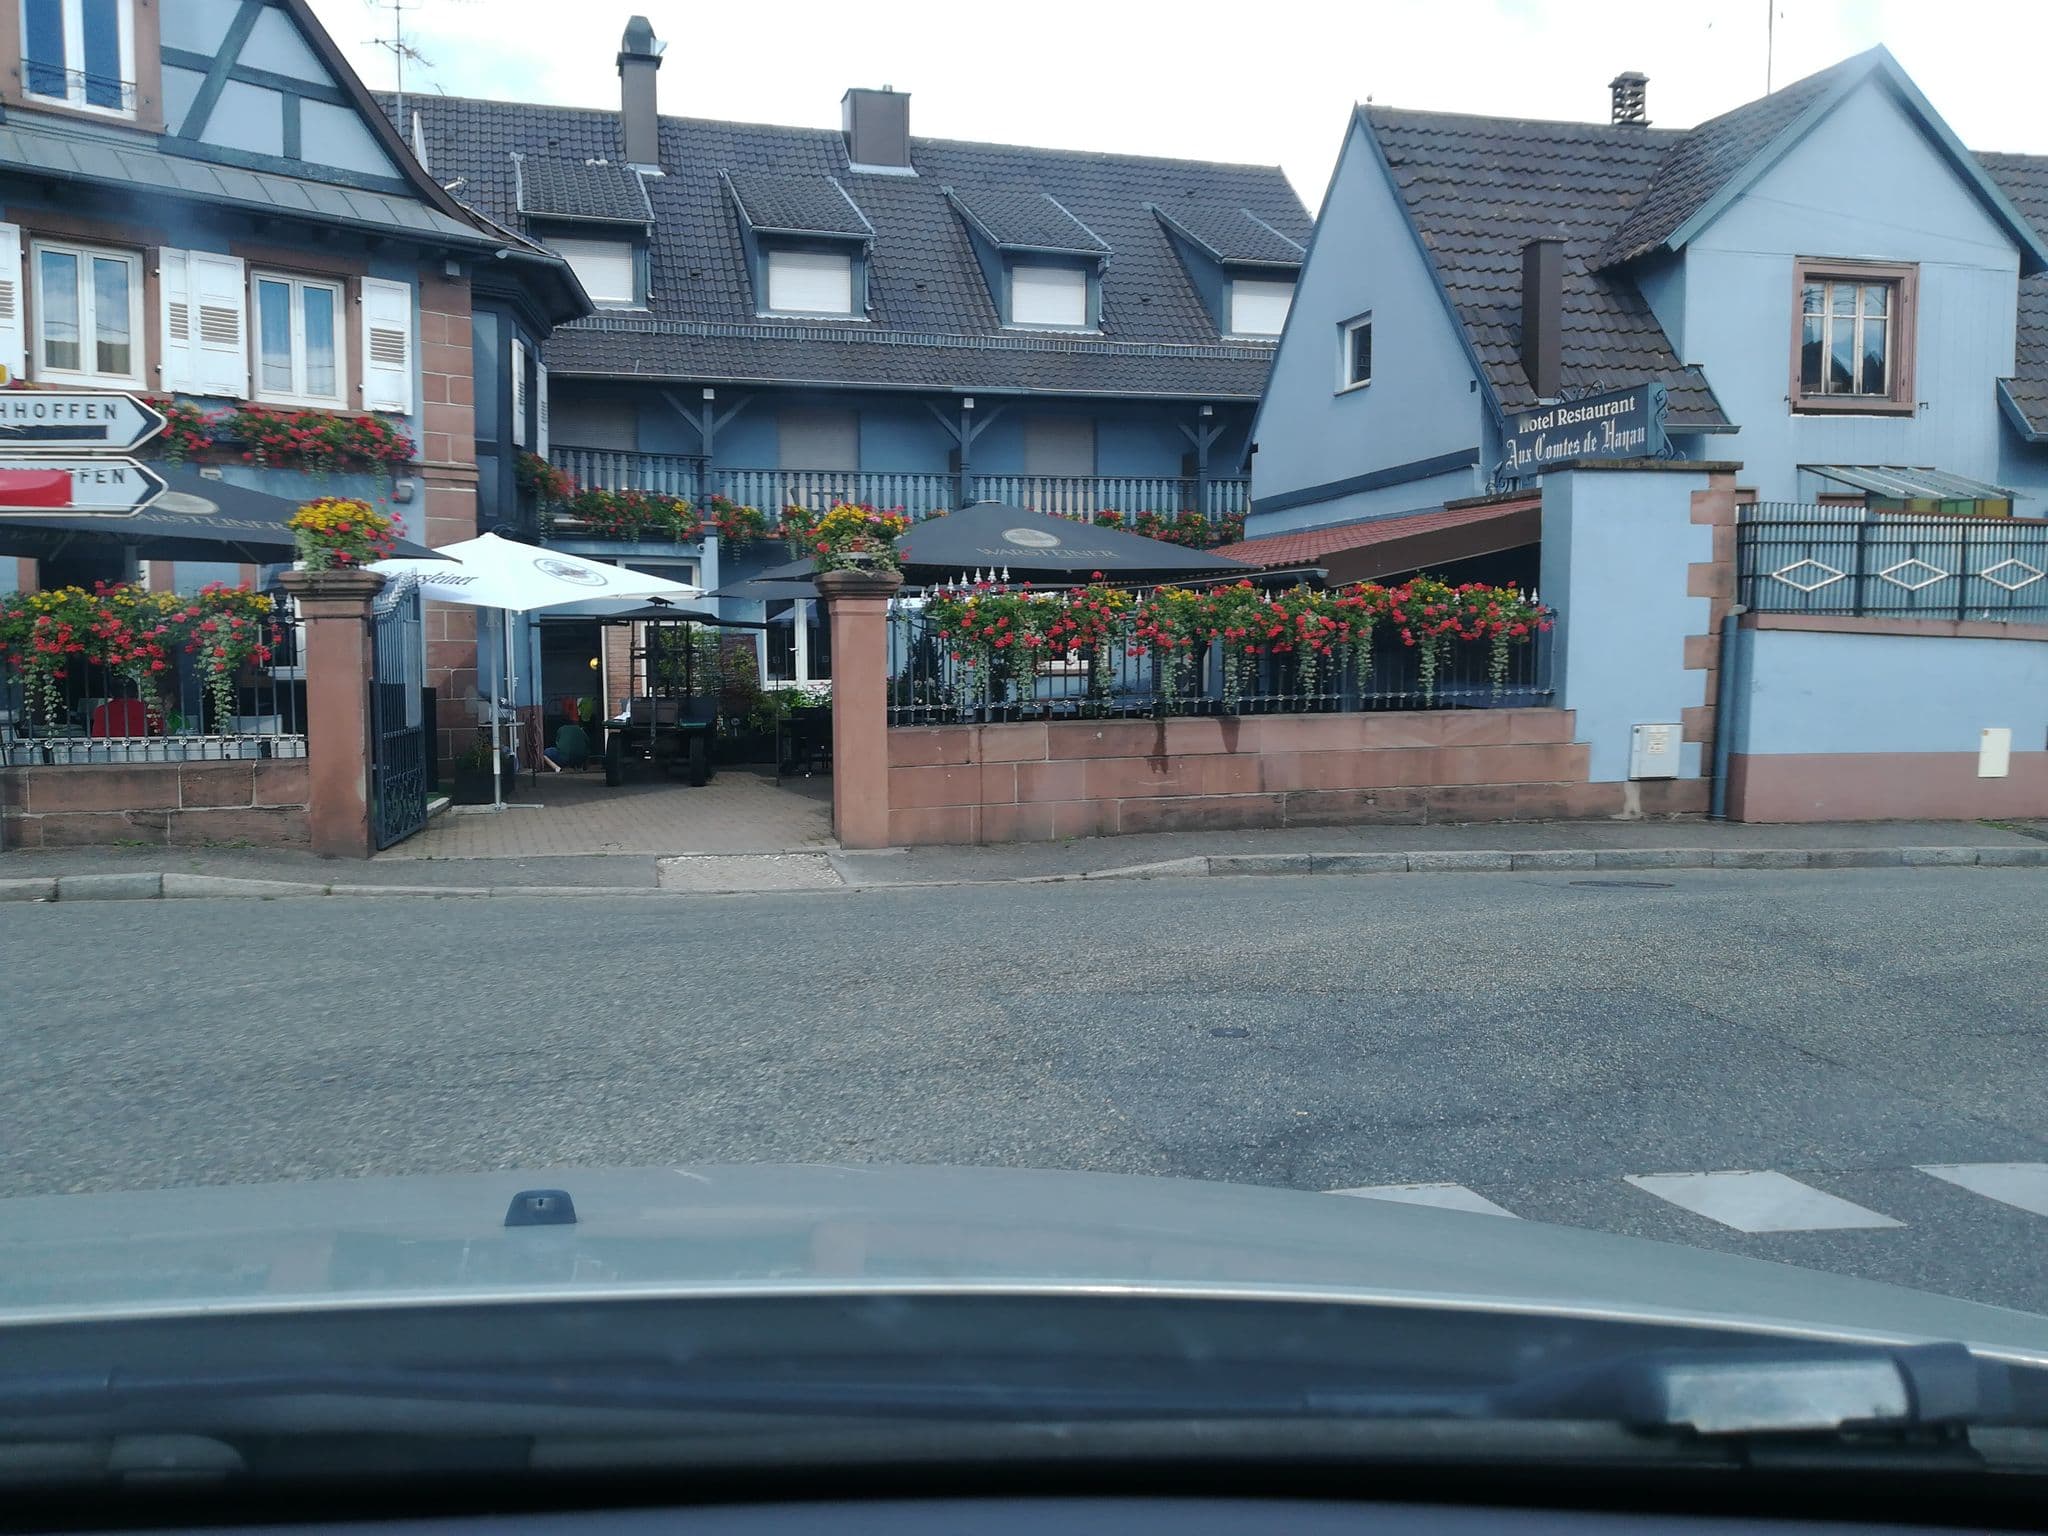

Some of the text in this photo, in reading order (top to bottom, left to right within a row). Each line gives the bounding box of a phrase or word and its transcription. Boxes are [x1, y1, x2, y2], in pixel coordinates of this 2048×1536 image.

[1558, 395, 1636, 426] Restaurant
[1505, 417, 1645, 471] Aux Comtes de Hanau
[975, 547, 1121, 560] WARSTEINER
